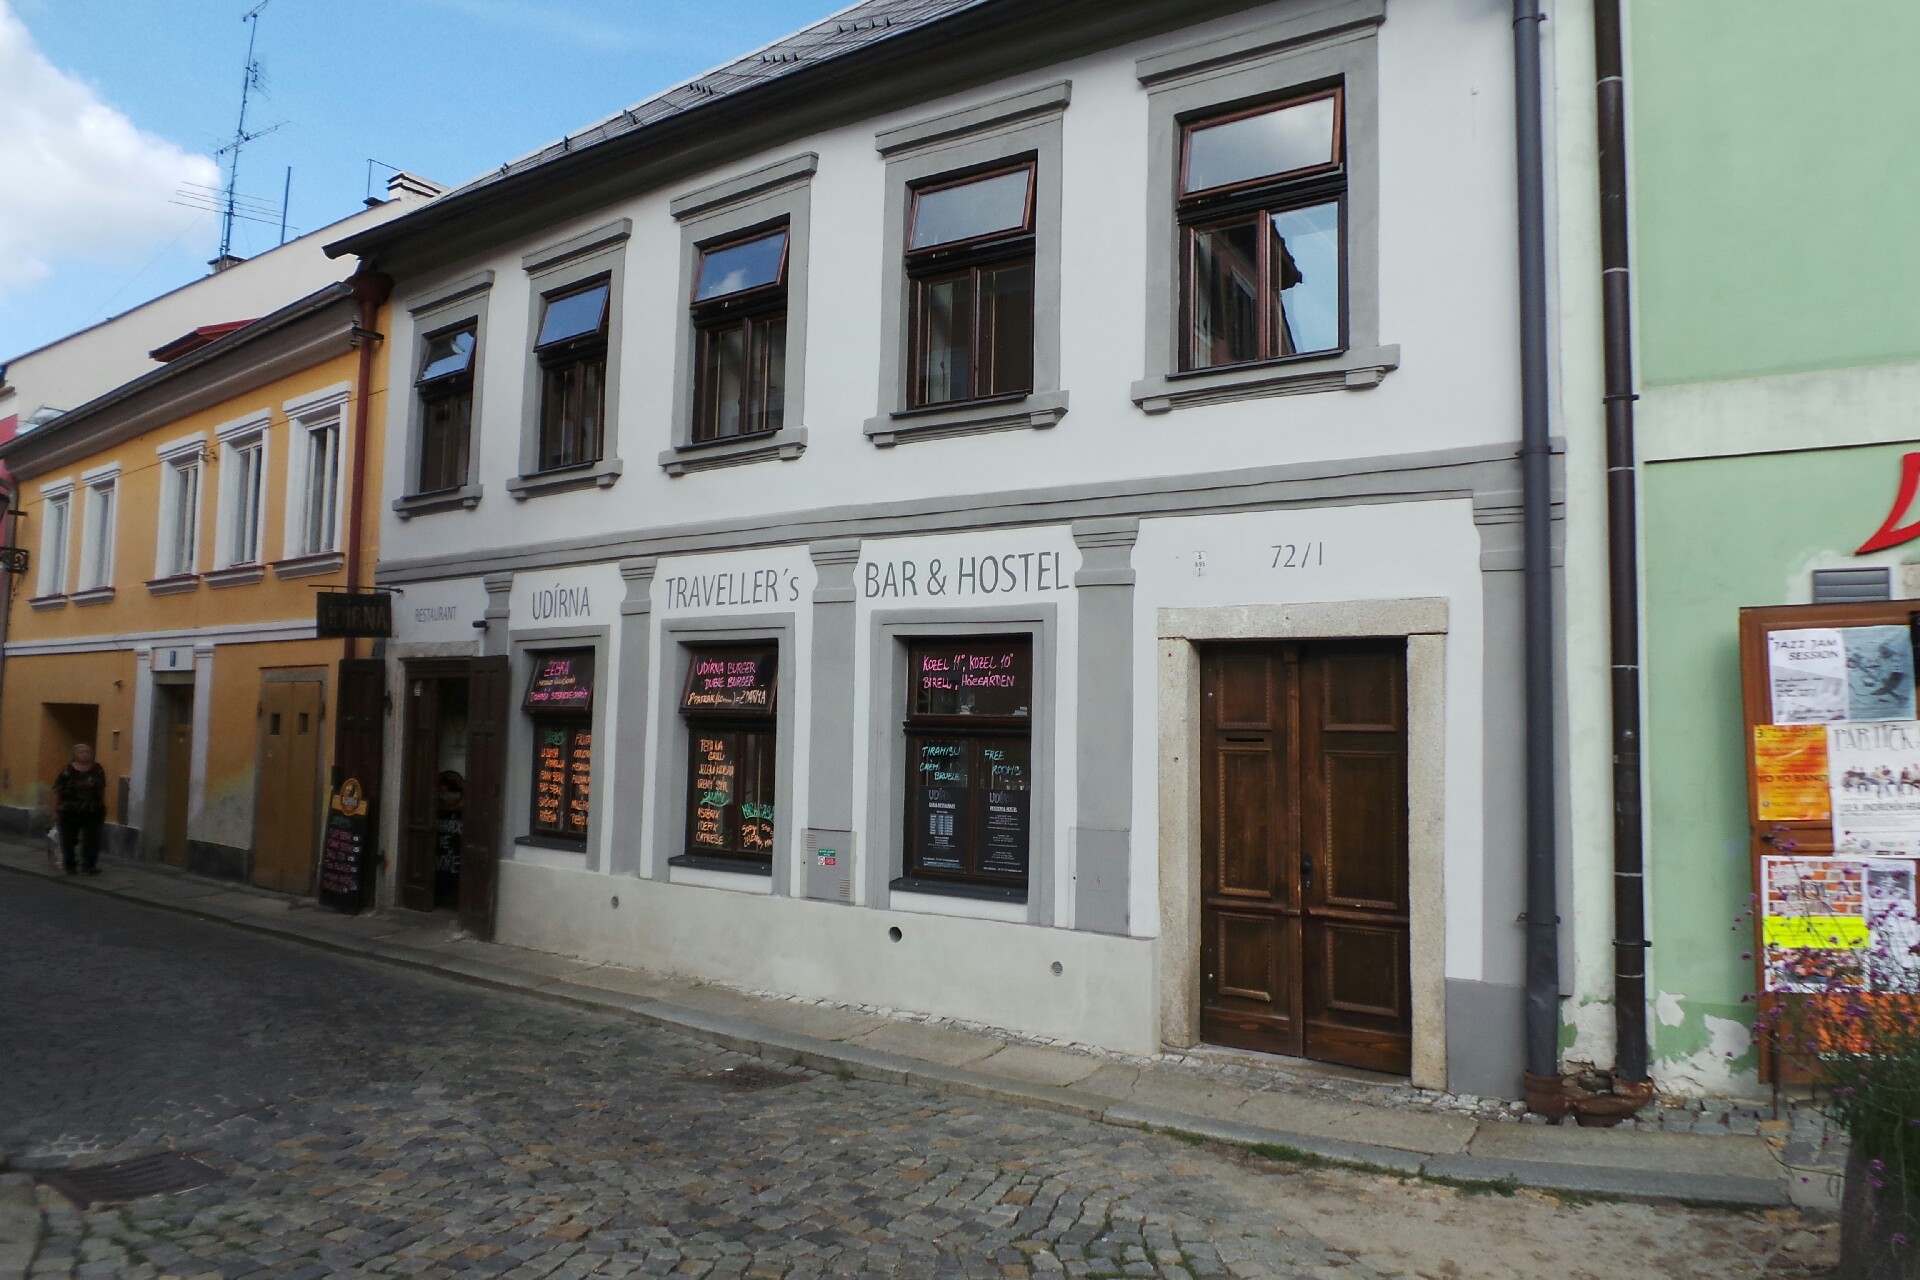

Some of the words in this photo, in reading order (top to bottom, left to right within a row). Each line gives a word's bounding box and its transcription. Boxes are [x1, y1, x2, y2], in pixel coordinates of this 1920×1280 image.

[864, 558, 919, 598] BAR
[926, 557, 948, 596] &
[957, 550, 1070, 596] HOSTEL
[532, 583, 591, 621] UDÍRNA
[415, 605, 457, 623] RESTAURANT
[1774, 640, 1806, 651] JAZZ
[1811, 638, 1838, 651] JAM
[1788, 650, 1840, 661] SESSION
[696, 658, 724, 675] UDÍRNA
[727, 661, 756, 675] BURGER
[922, 654, 950, 671] KOZEL
[969, 655, 997, 670] KOZEL
[727, 675, 755, 688] BURGER
[921, 745, 961, 757] TIRAMISU
[984, 749, 1005, 761] FREE
[991, 764, 1022, 776] ROOMS
